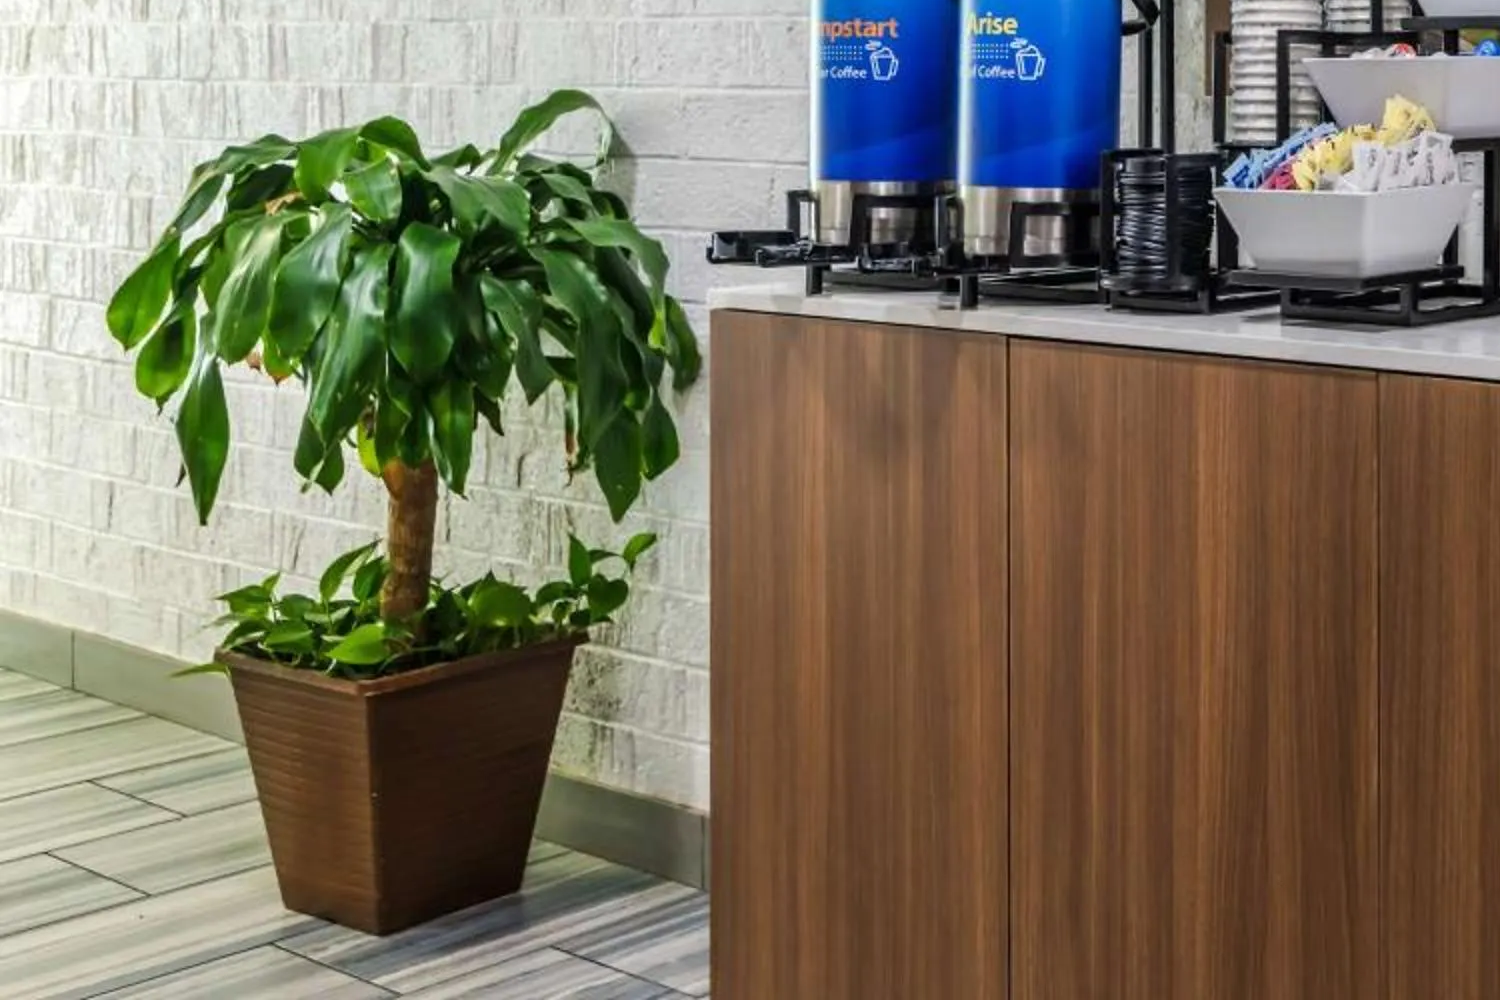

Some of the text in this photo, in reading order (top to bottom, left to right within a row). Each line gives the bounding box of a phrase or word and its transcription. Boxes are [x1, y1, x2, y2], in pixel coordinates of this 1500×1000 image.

[967, 11, 1018, 35] Arise
[829, 65, 868, 79] Coffee
[977, 64, 1016, 79] Coffee
